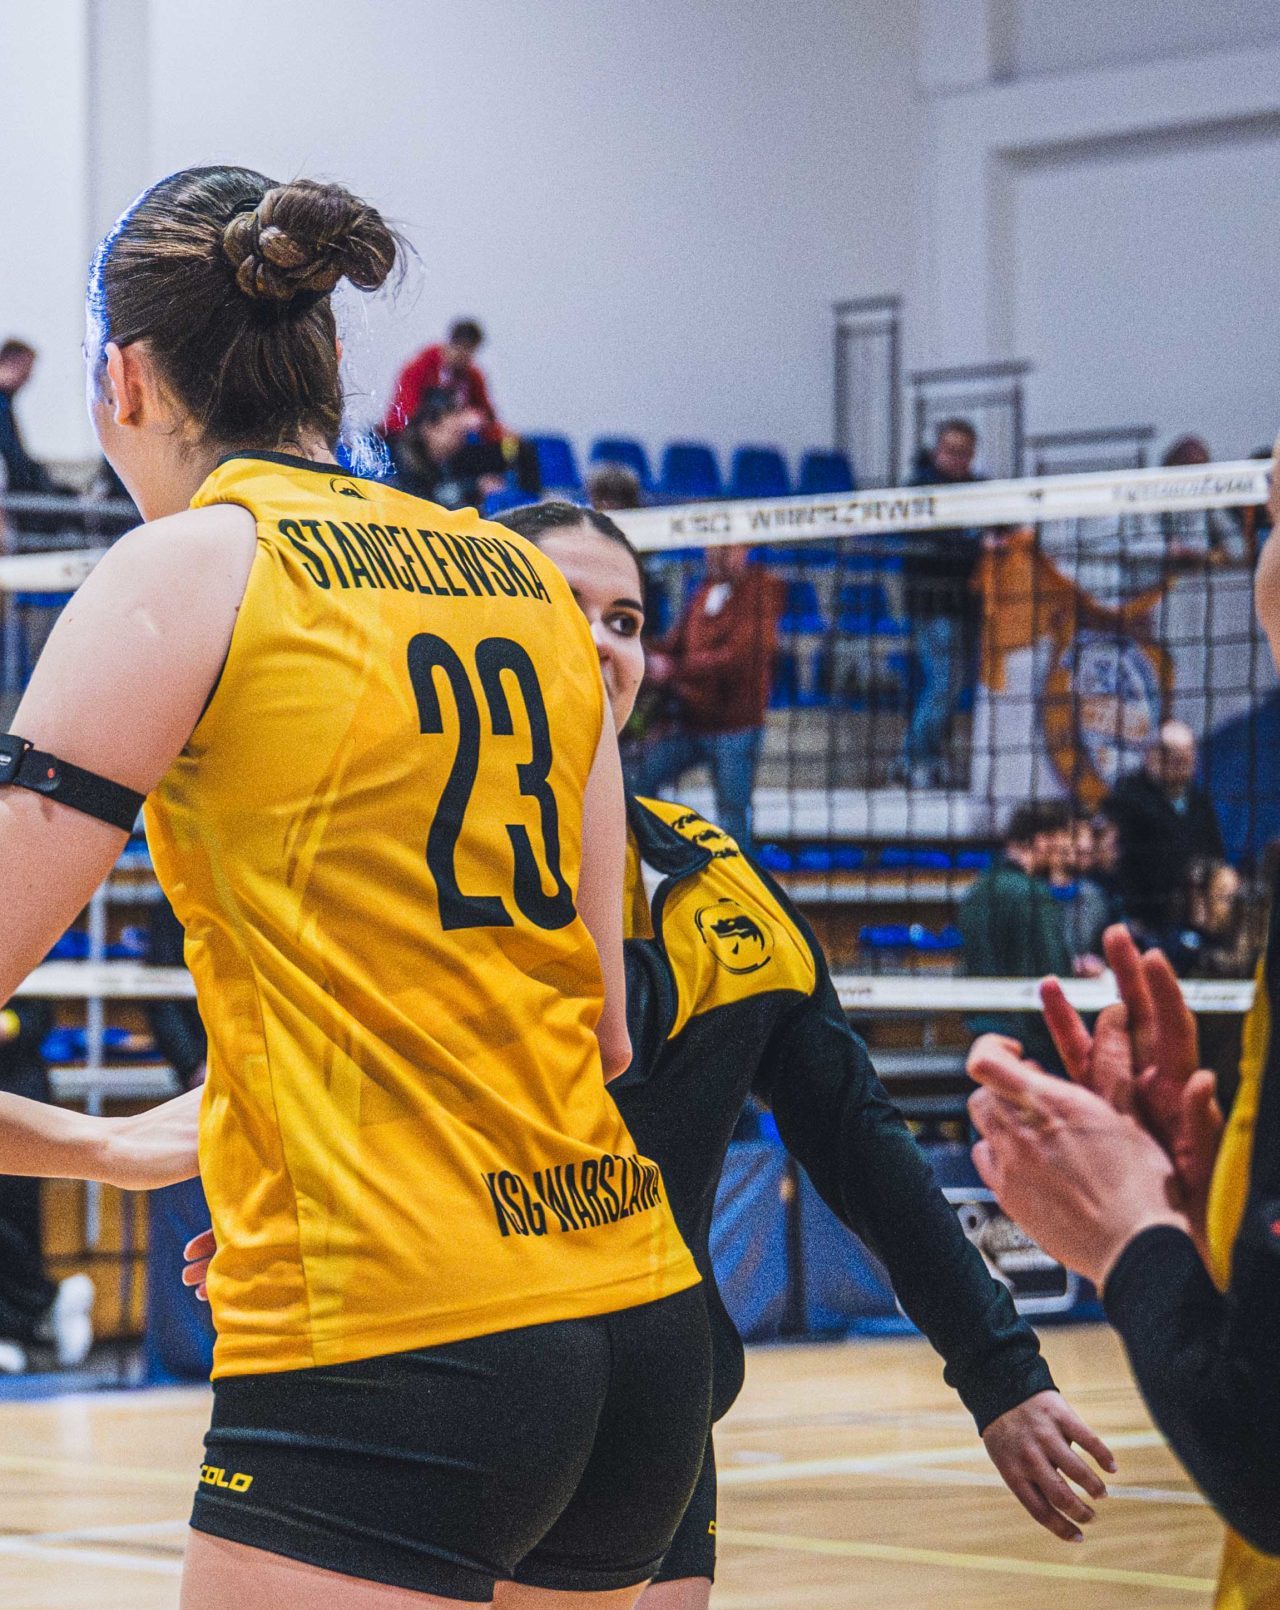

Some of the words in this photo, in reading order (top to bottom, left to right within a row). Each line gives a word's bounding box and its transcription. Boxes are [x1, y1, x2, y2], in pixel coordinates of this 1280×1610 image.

[278, 518, 552, 604] STANCELEWSKA
[407, 632, 577, 931] 23
[481, 1170, 548, 1237] KSG
